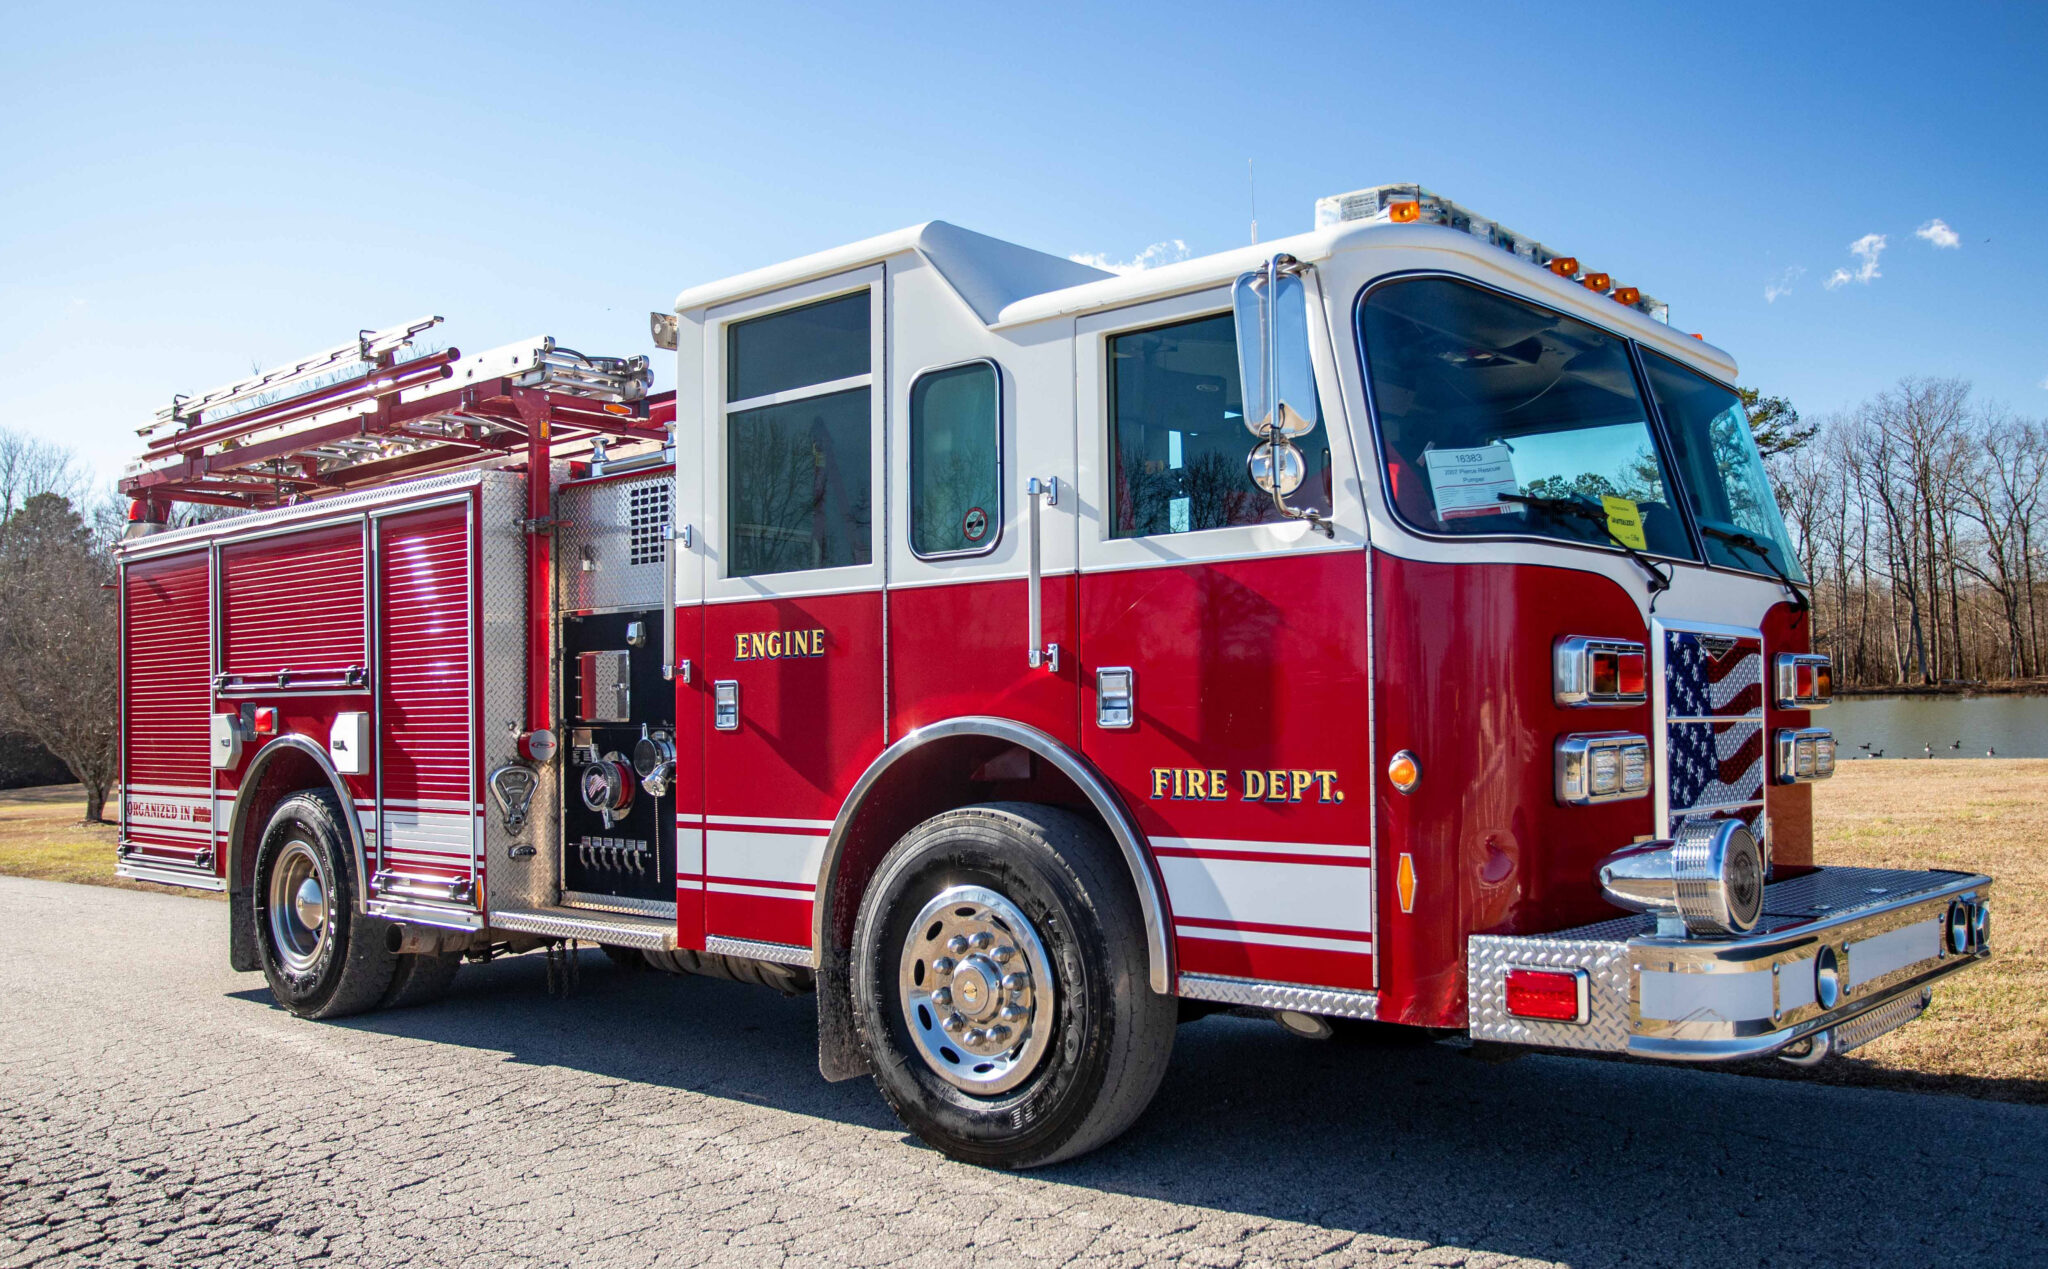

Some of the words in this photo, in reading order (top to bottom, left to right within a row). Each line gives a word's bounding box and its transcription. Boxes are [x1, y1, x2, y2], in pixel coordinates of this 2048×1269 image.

[1455, 453, 1483, 463] 16383
[734, 629, 825, 661] ENGINE
[1150, 768, 1228, 801] FIRE
[1240, 769, 1345, 804] DEPT.
[127, 801, 178, 820] ORGANIZED
[180, 805, 191, 821] IN
